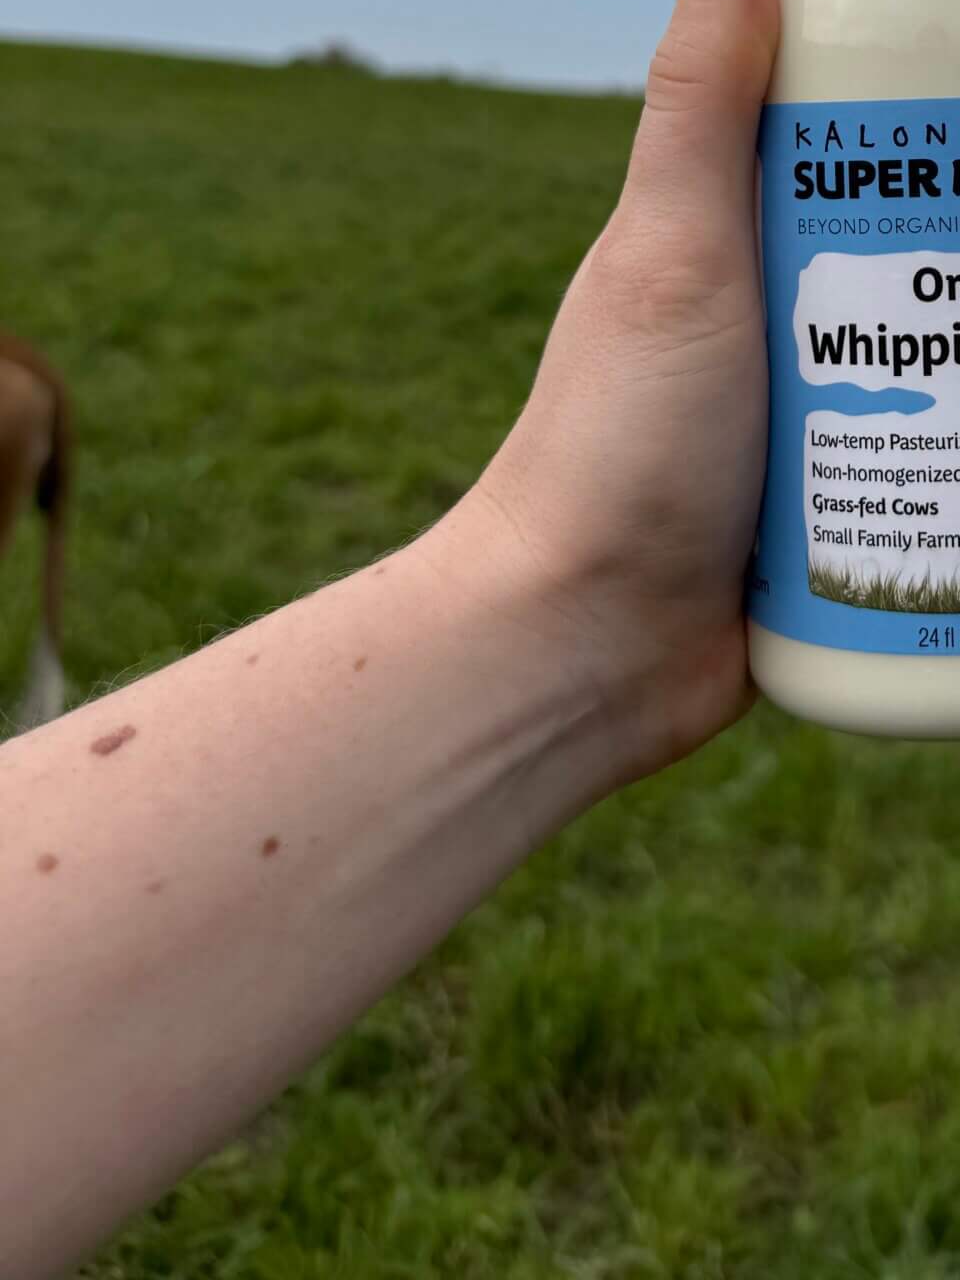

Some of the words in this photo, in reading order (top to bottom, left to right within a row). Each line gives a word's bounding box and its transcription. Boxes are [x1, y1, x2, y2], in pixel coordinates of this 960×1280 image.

[794, 158, 942, 200] SUPER
[797, 217, 871, 236] BEYOND
[810, 429, 886, 454] Low-temp
[812, 493, 888, 518] Grass-fed
[891, 498, 940, 516] Cows
[812, 524, 853, 546] Small
[857, 528, 913, 552] Family
[918, 626, 939, 648] 24
[944, 625, 955, 648] fl
